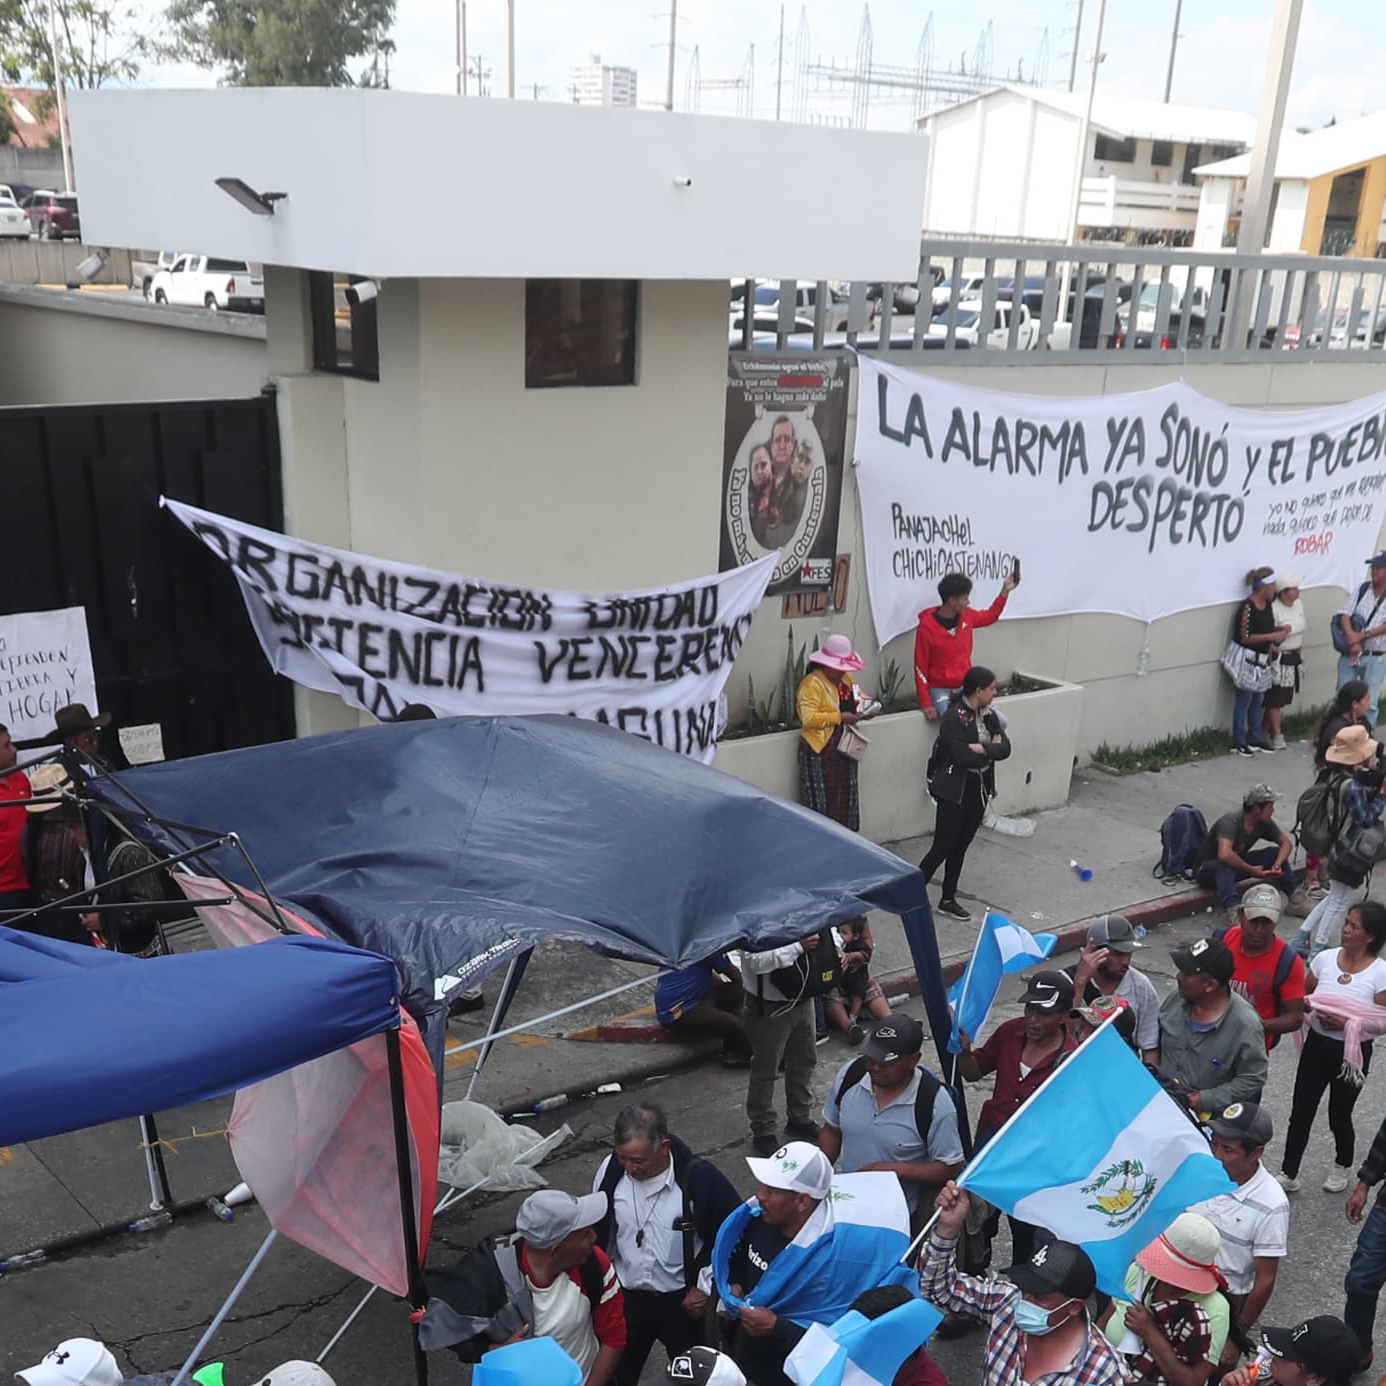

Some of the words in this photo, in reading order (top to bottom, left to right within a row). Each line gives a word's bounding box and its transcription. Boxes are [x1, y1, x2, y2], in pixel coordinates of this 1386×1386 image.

[878, 372, 933, 459] LA
[942, 407, 1089, 485] ALARMA
[1104, 416, 1146, 473] YA
[1268, 437, 1296, 486] EL
[793, 465, 825, 558] Guatemala
[66, 667, 79, 688] Y
